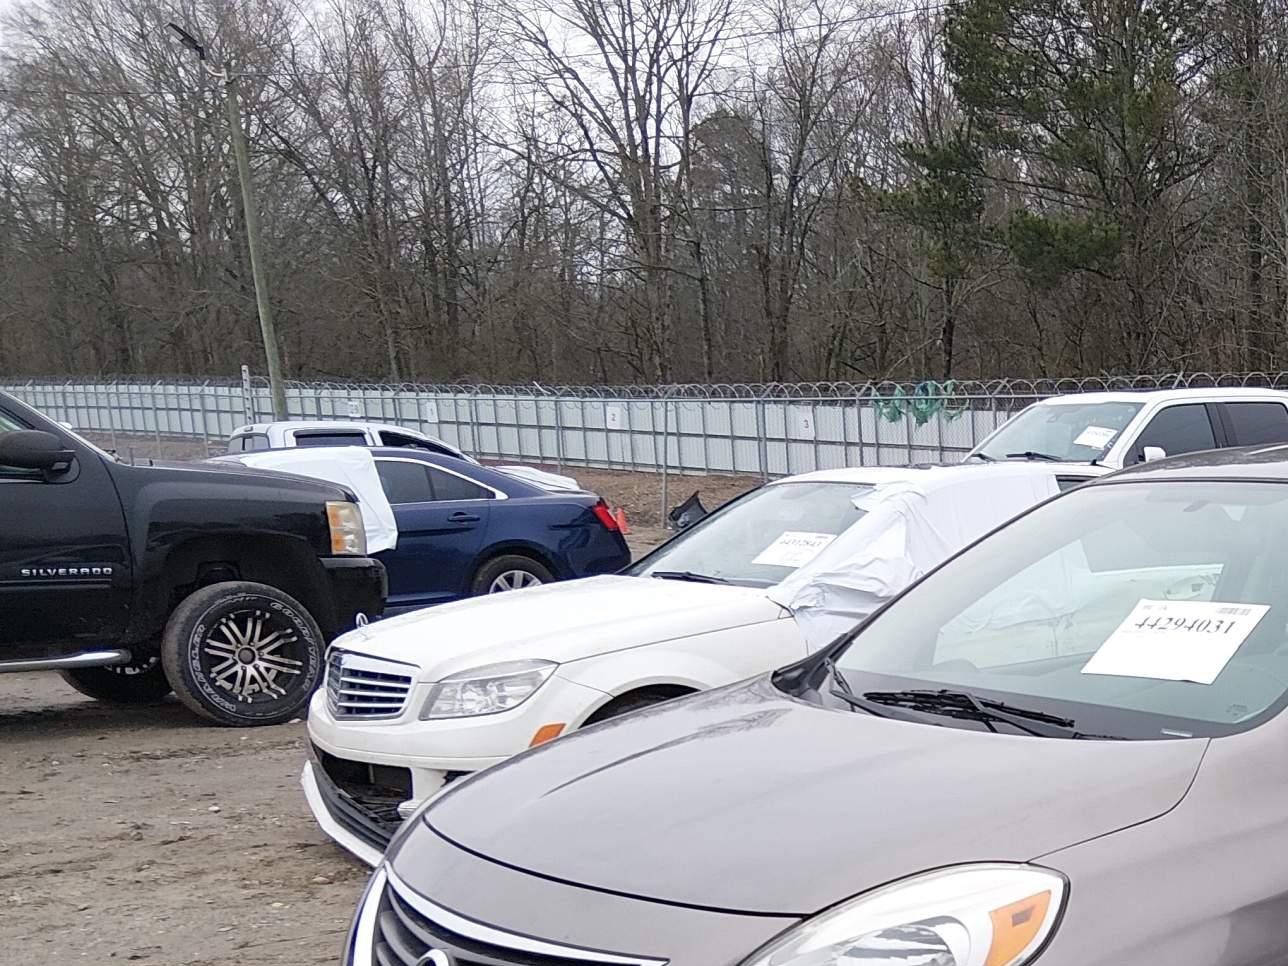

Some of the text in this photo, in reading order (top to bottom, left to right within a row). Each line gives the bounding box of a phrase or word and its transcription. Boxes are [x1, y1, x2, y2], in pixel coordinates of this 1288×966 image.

[803, 419, 810, 429] 3
[20, 567, 113, 577] SILVERADO
[1134, 615, 1237, 635] 44294031
[270, 601, 318, 691] GOODYEAR
